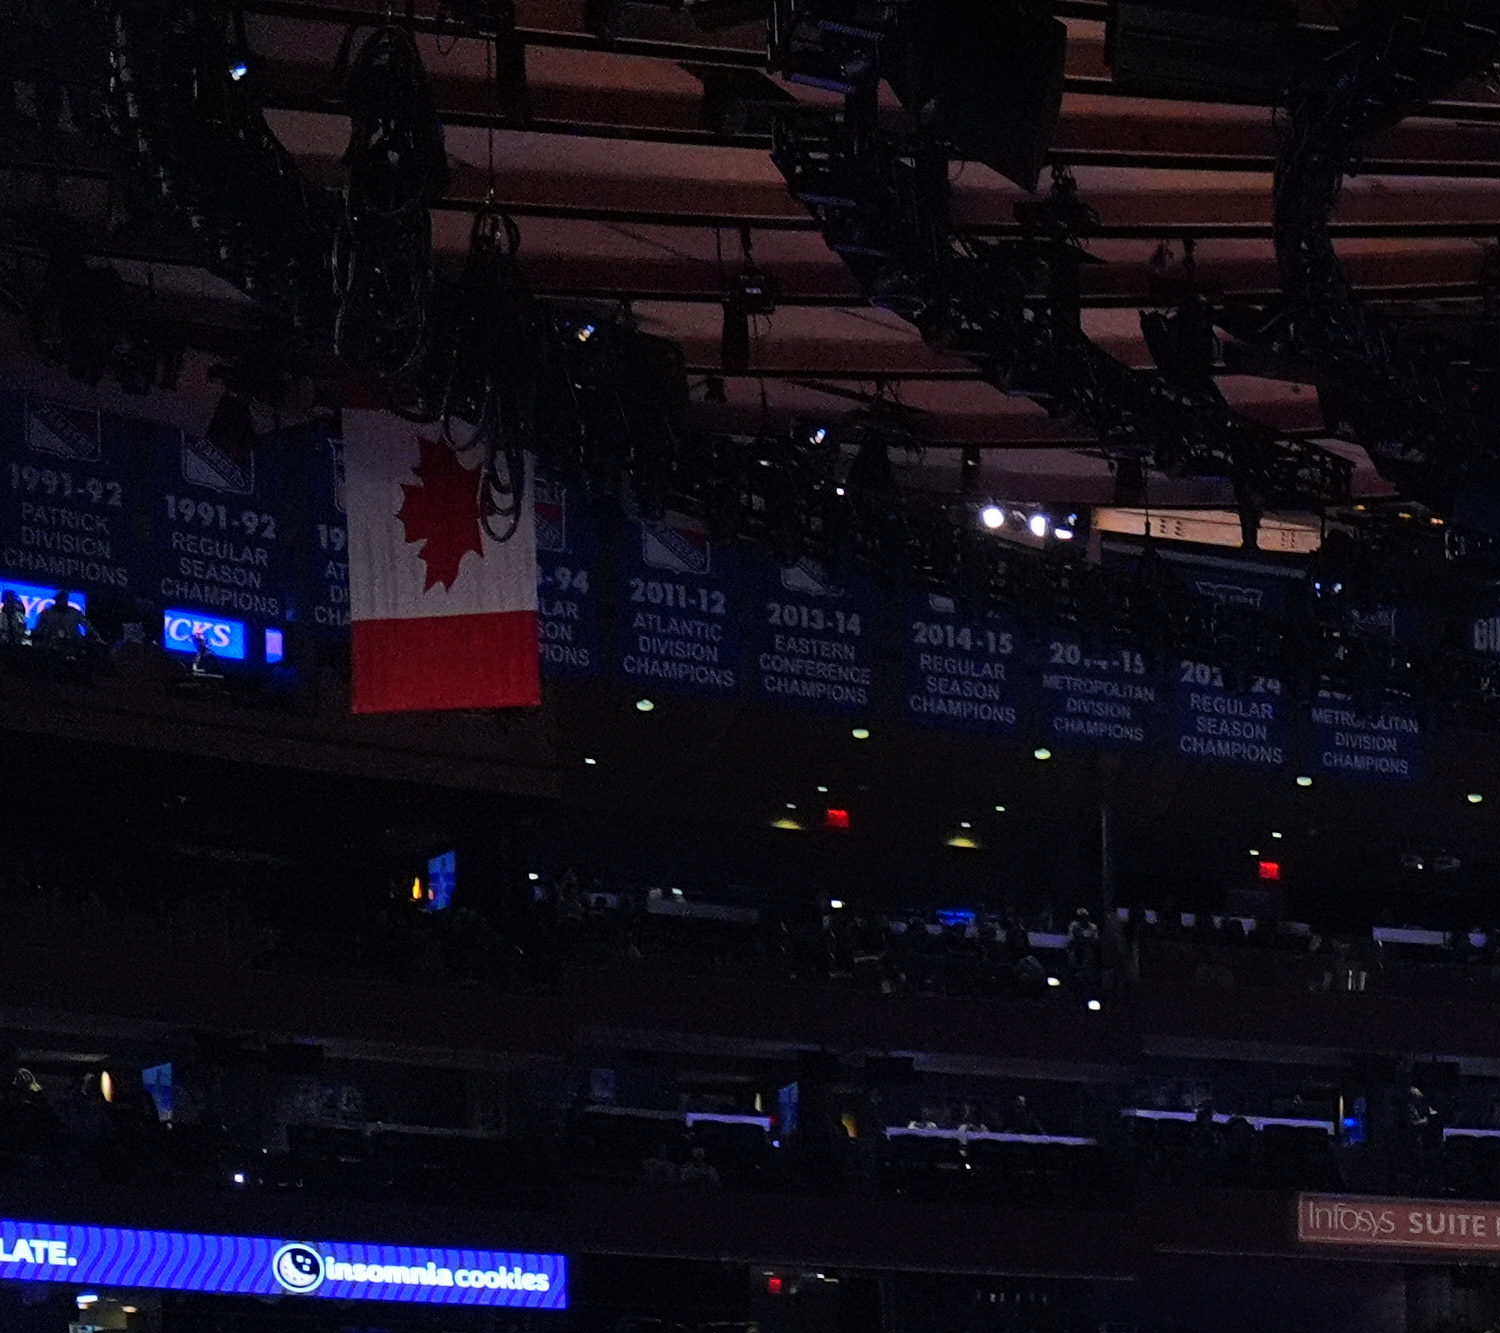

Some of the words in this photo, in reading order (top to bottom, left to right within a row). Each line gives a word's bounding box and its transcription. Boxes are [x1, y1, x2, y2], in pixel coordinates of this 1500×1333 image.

[623, 654, 736, 688] CHAMPIONS
[919, 652, 1006, 682] REGULAR
[925, 674, 1000, 701] SEASON
[909, 693, 1017, 725] CHAMPIONS
[1307, 1200, 1396, 1237] Infosys
[1408, 1211, 1487, 1237] SUITE
[324, 1256, 453, 1287] insomnia
[455, 1262, 550, 1292] cookies
